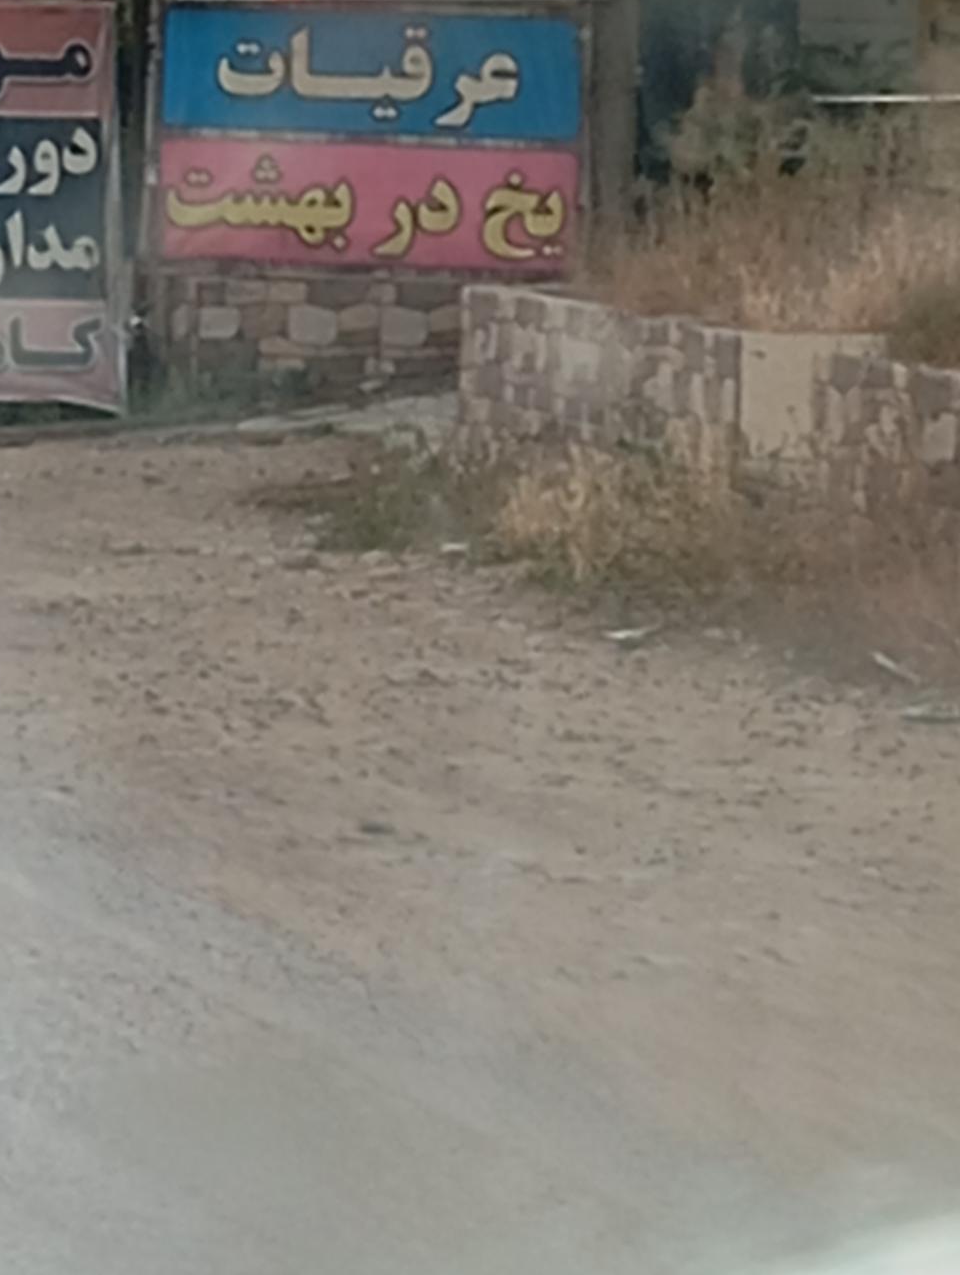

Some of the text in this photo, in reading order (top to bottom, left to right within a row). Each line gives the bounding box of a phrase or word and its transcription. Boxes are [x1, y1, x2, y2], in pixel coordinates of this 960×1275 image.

[216, 26, 520, 127] عرقیات
[165, 152, 566, 259] یخ در بهشت
